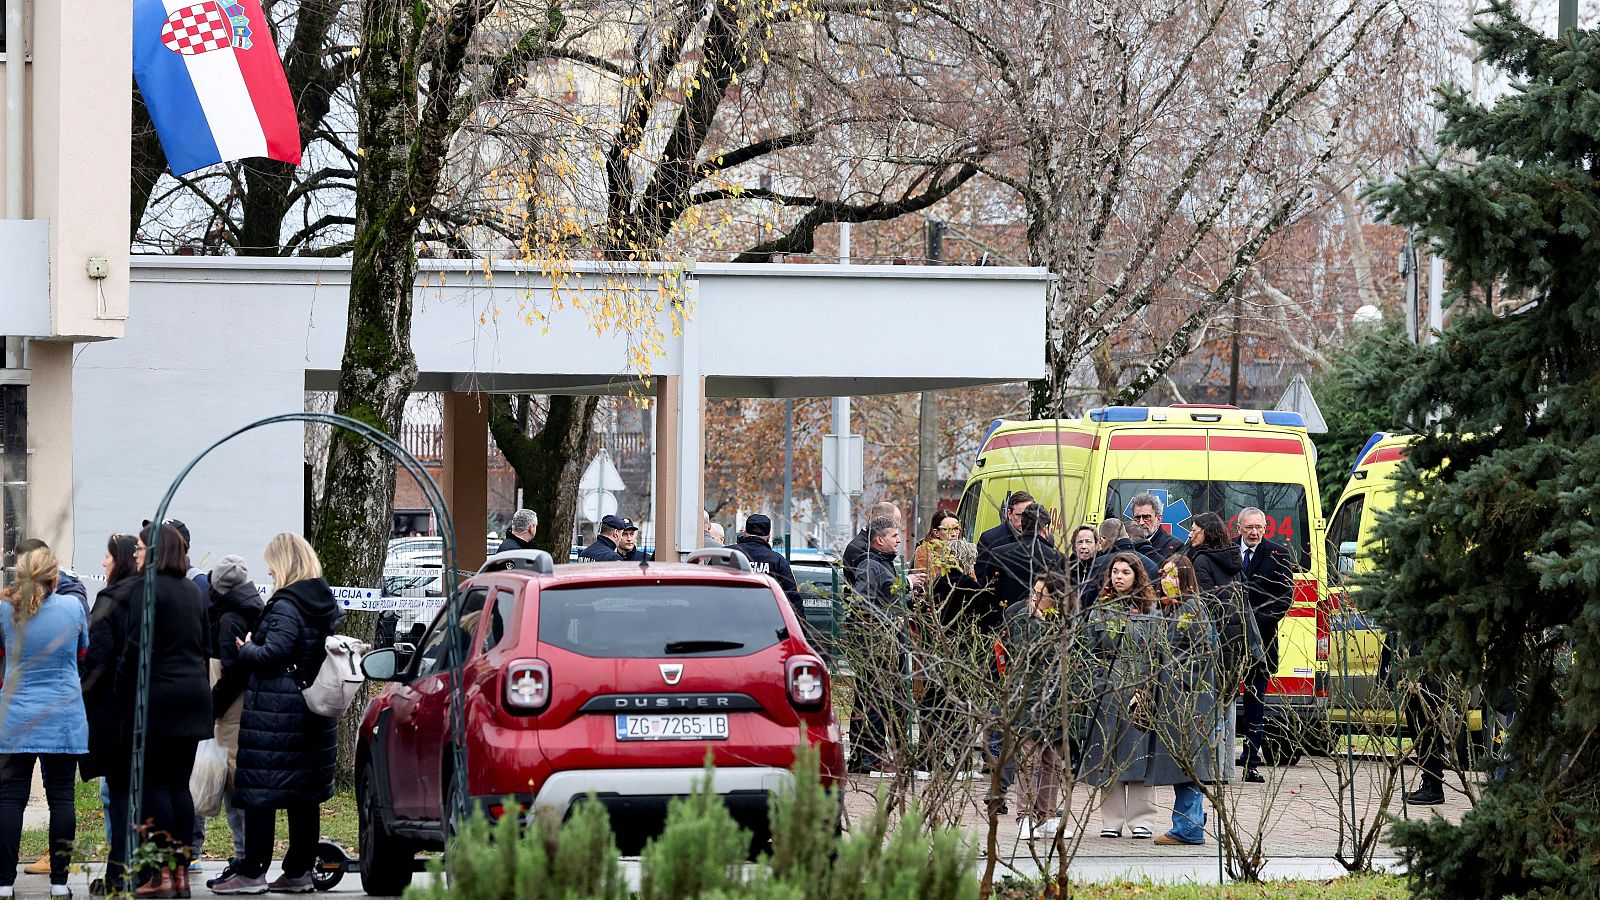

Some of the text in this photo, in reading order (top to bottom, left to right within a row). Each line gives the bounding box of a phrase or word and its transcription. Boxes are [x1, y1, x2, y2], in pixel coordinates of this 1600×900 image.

[750, 561, 770, 574] CIJA
[333, 589, 362, 599] LICIJA
[615, 697, 729, 708] DUSTER
[629, 717, 650, 735] ZG
